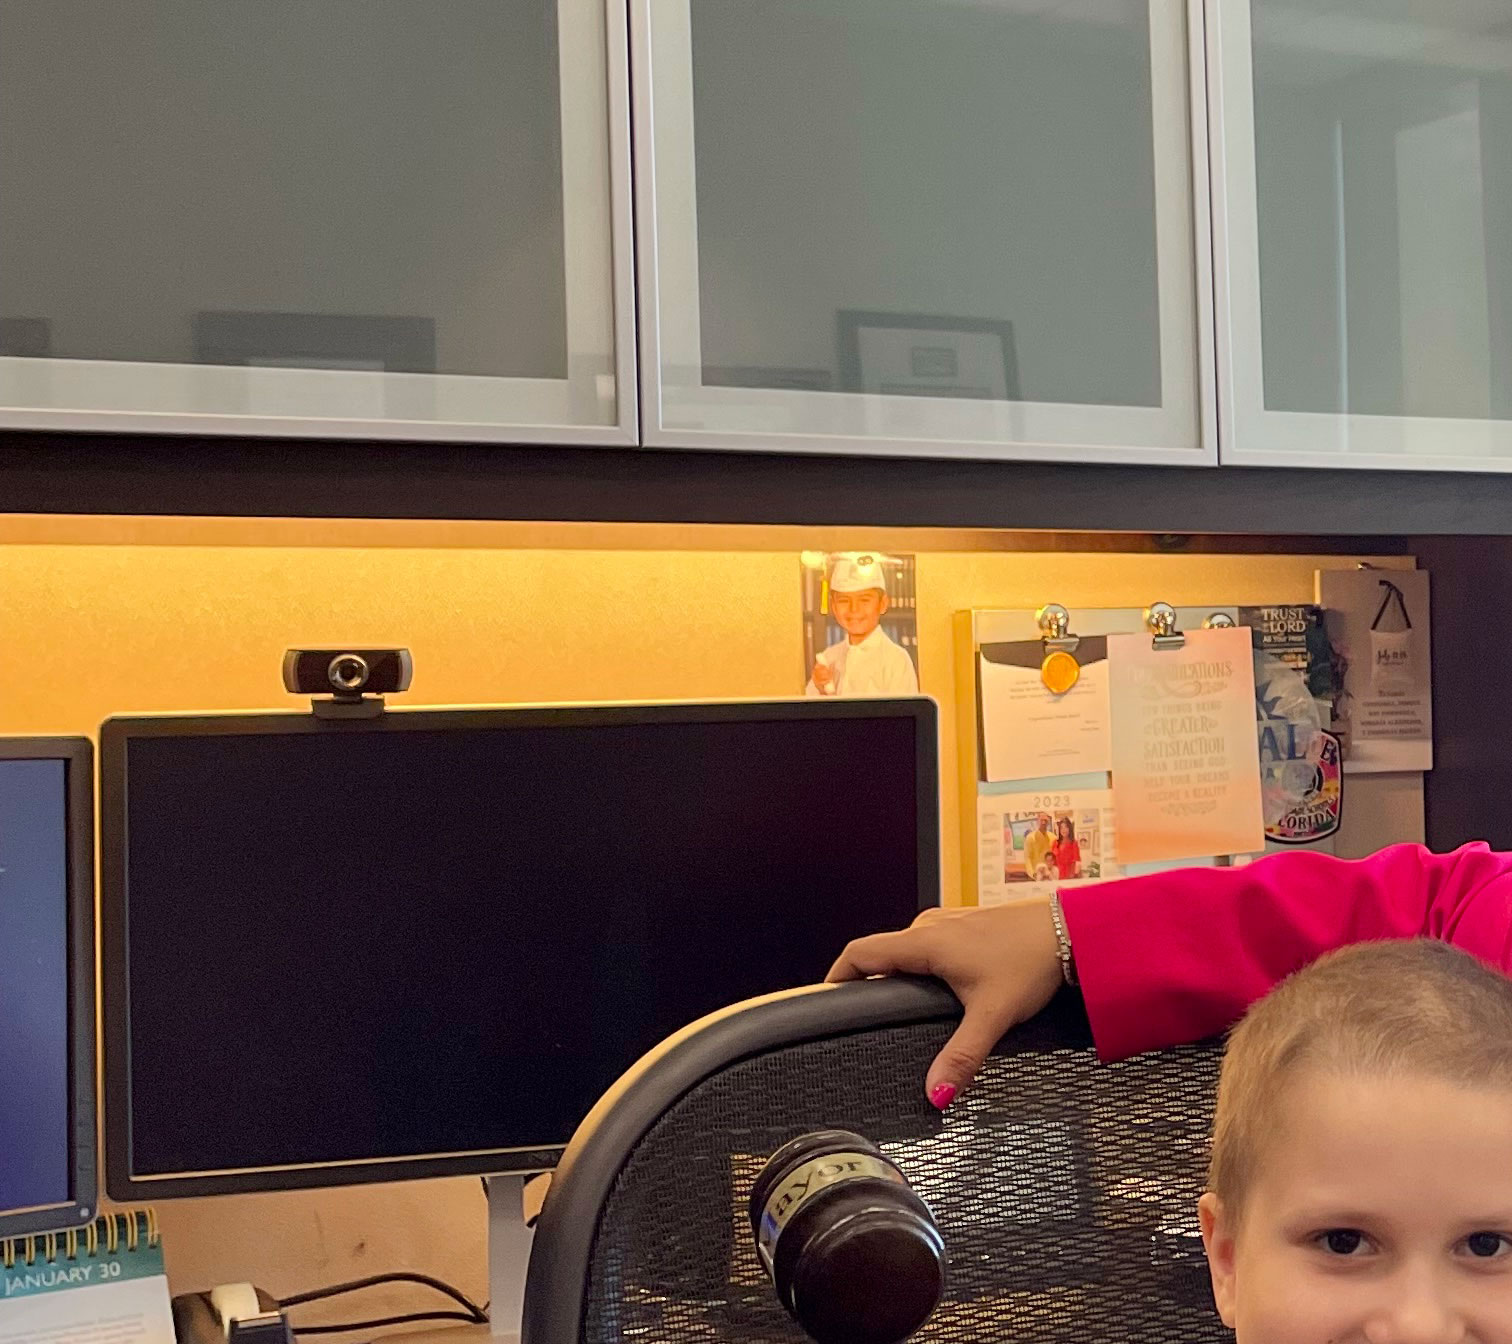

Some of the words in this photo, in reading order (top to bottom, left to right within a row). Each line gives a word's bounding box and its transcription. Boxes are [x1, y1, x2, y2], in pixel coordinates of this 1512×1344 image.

[1261, 607, 1305, 621] TRUST
[1270, 620, 1306, 633] LORD
[1033, 795, 1070, 808] 2023
[775, 1161, 862, 1217] ayor
[5, 1264, 93, 1297] JANUARY
[99, 1261, 121, 1279] 30
